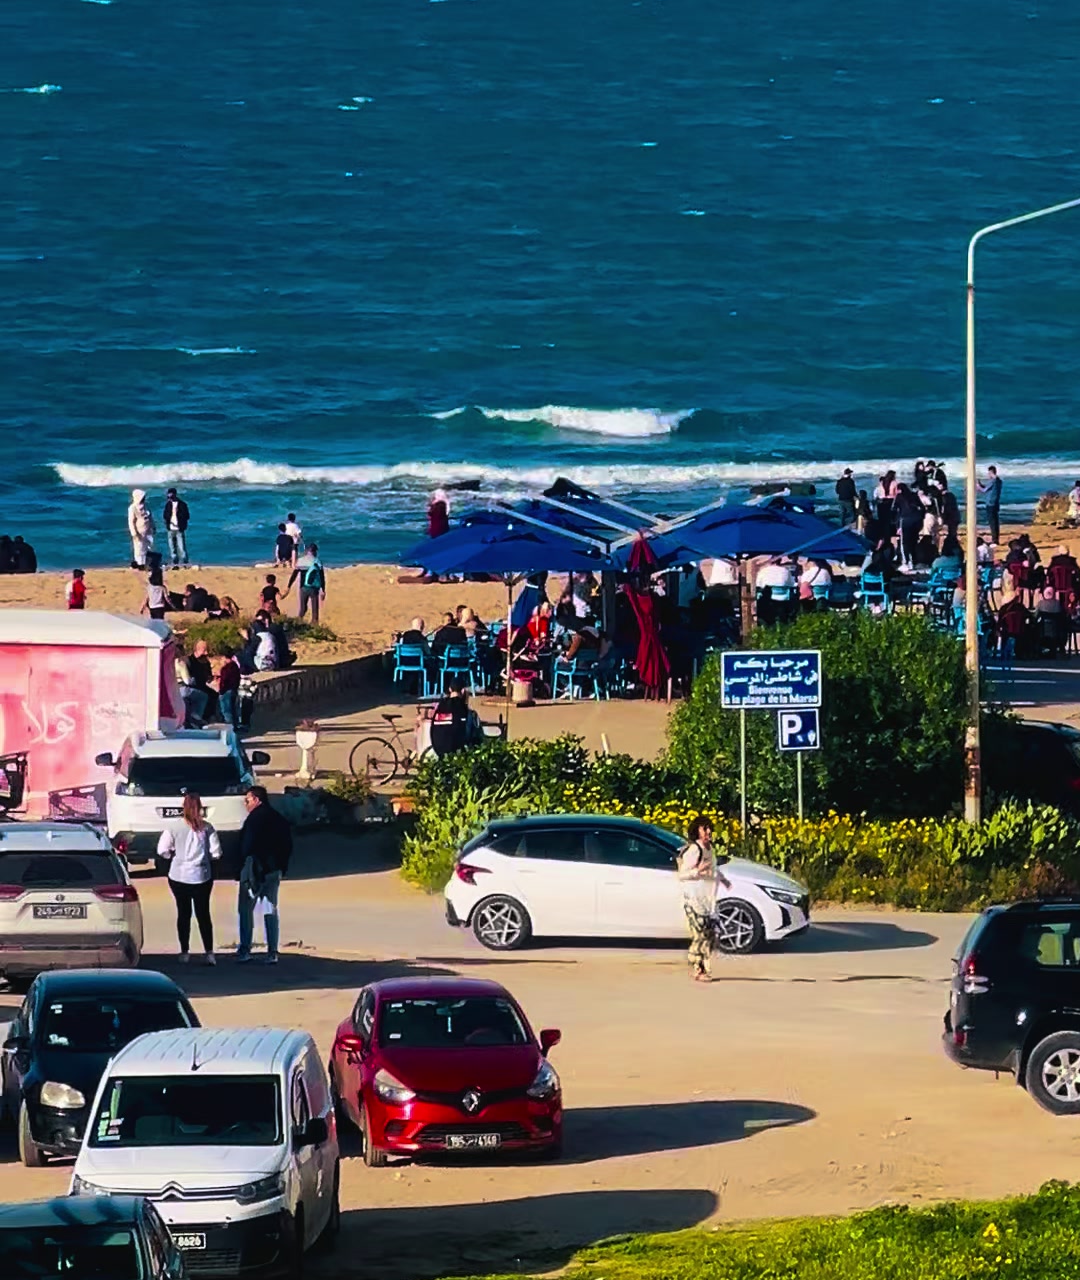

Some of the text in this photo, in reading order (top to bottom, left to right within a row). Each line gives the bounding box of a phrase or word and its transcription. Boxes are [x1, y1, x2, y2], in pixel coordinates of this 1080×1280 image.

[733, 657, 809, 671] مرحبا بكم
[781, 714, 803, 745] P
